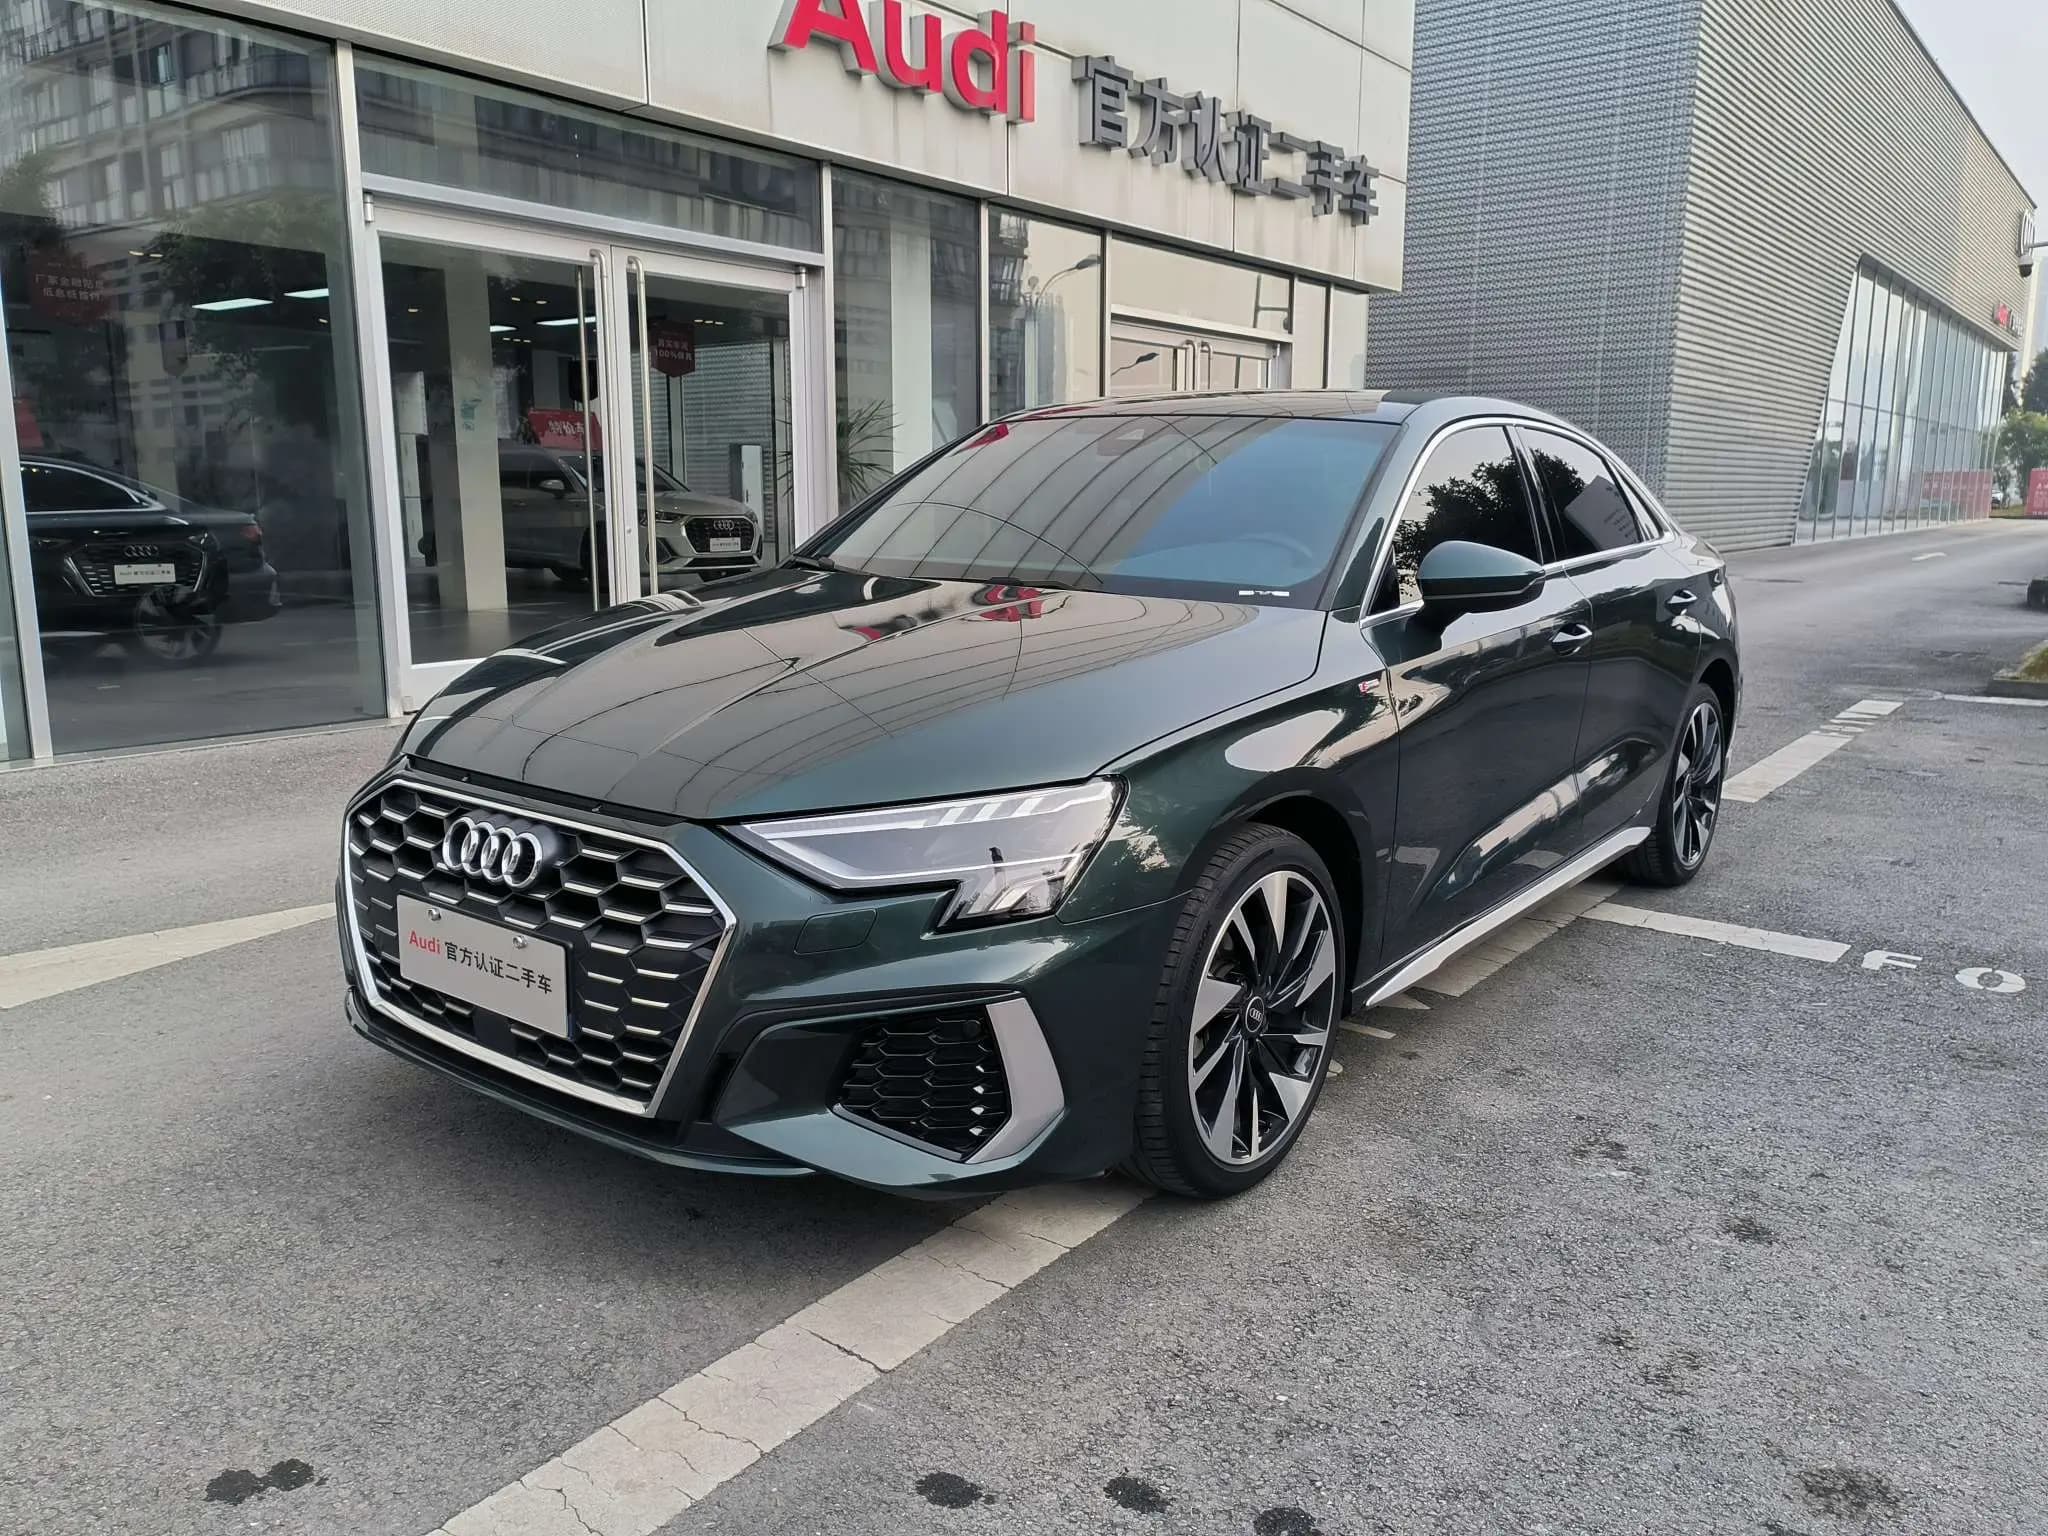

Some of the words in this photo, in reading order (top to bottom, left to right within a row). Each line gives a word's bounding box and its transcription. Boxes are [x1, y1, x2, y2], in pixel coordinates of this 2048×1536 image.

[772, 0, 1035, 124] Audi
[1072, 54, 1379, 225] 官方认证二手车
[409, 930, 441, 955] Audi
[445, 942, 552, 995] 官方认证二手车
